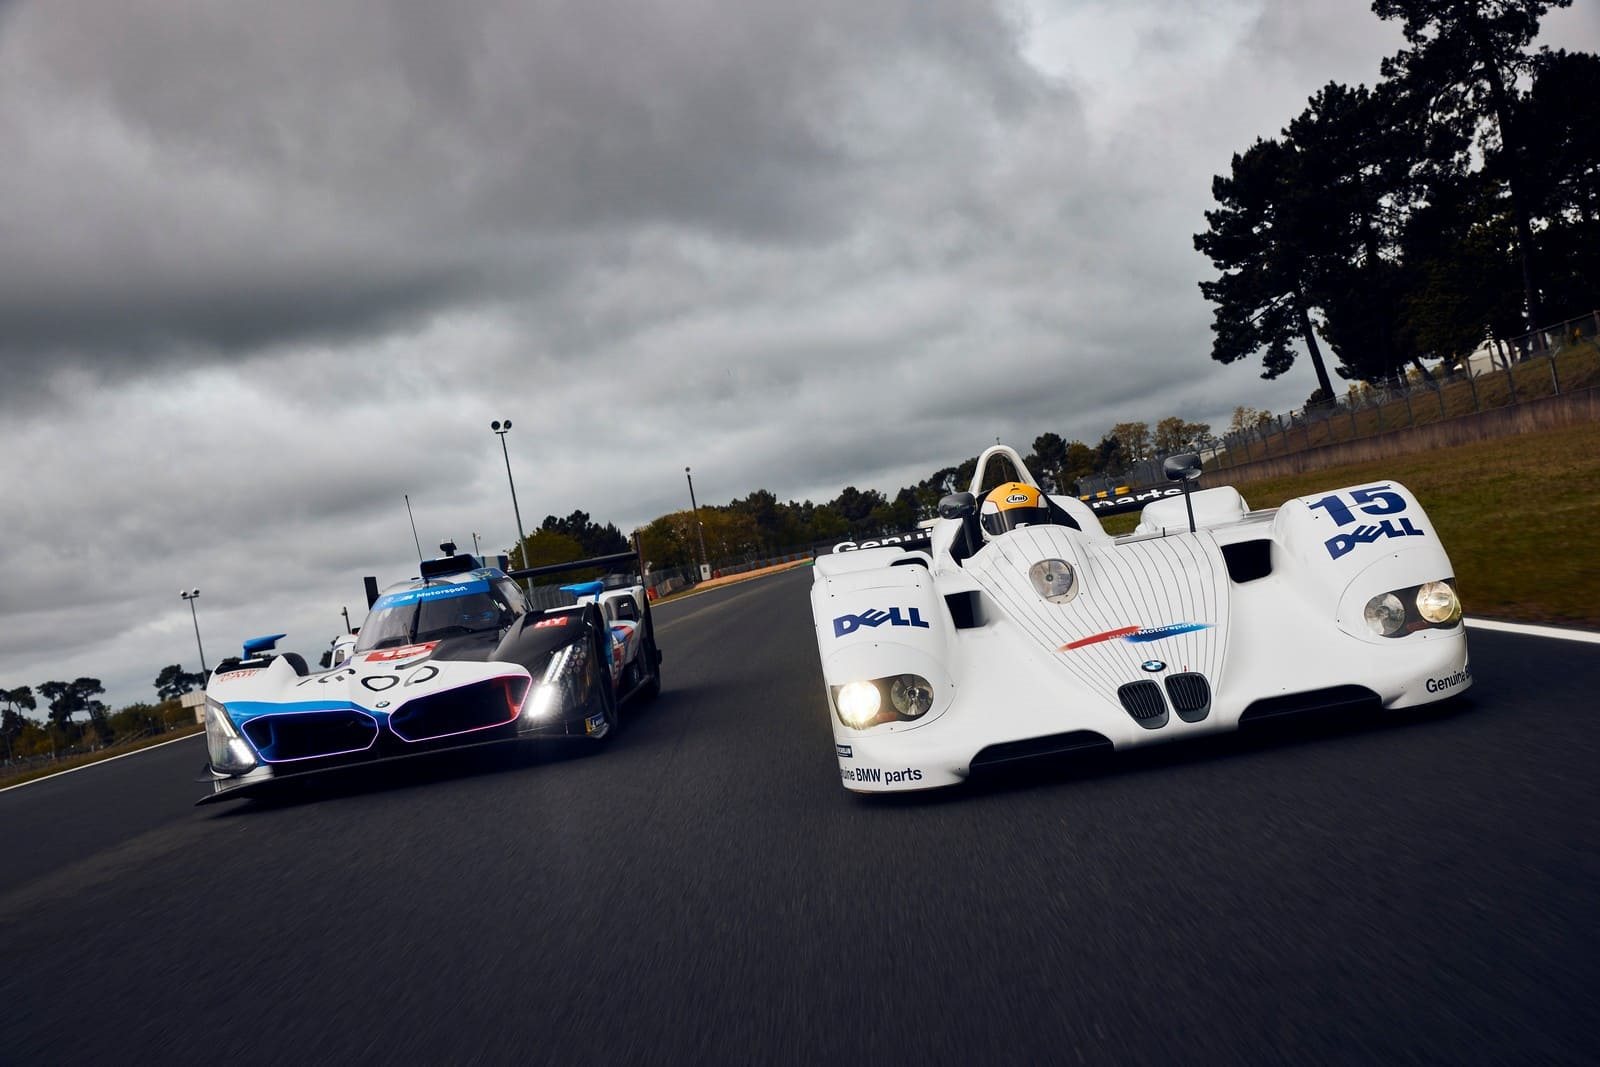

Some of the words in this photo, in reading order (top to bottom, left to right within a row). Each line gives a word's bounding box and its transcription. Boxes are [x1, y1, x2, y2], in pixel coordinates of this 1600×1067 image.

[1308, 486, 1407, 527] 15
[1324, 517, 1425, 560] DELL
[416, 586, 468, 598] Motorsport
[833, 607, 929, 638] DELL
[1138, 623, 1197, 636] Motorsport
[856, 768, 881, 782] BMW
[885, 768, 922, 786] parts
